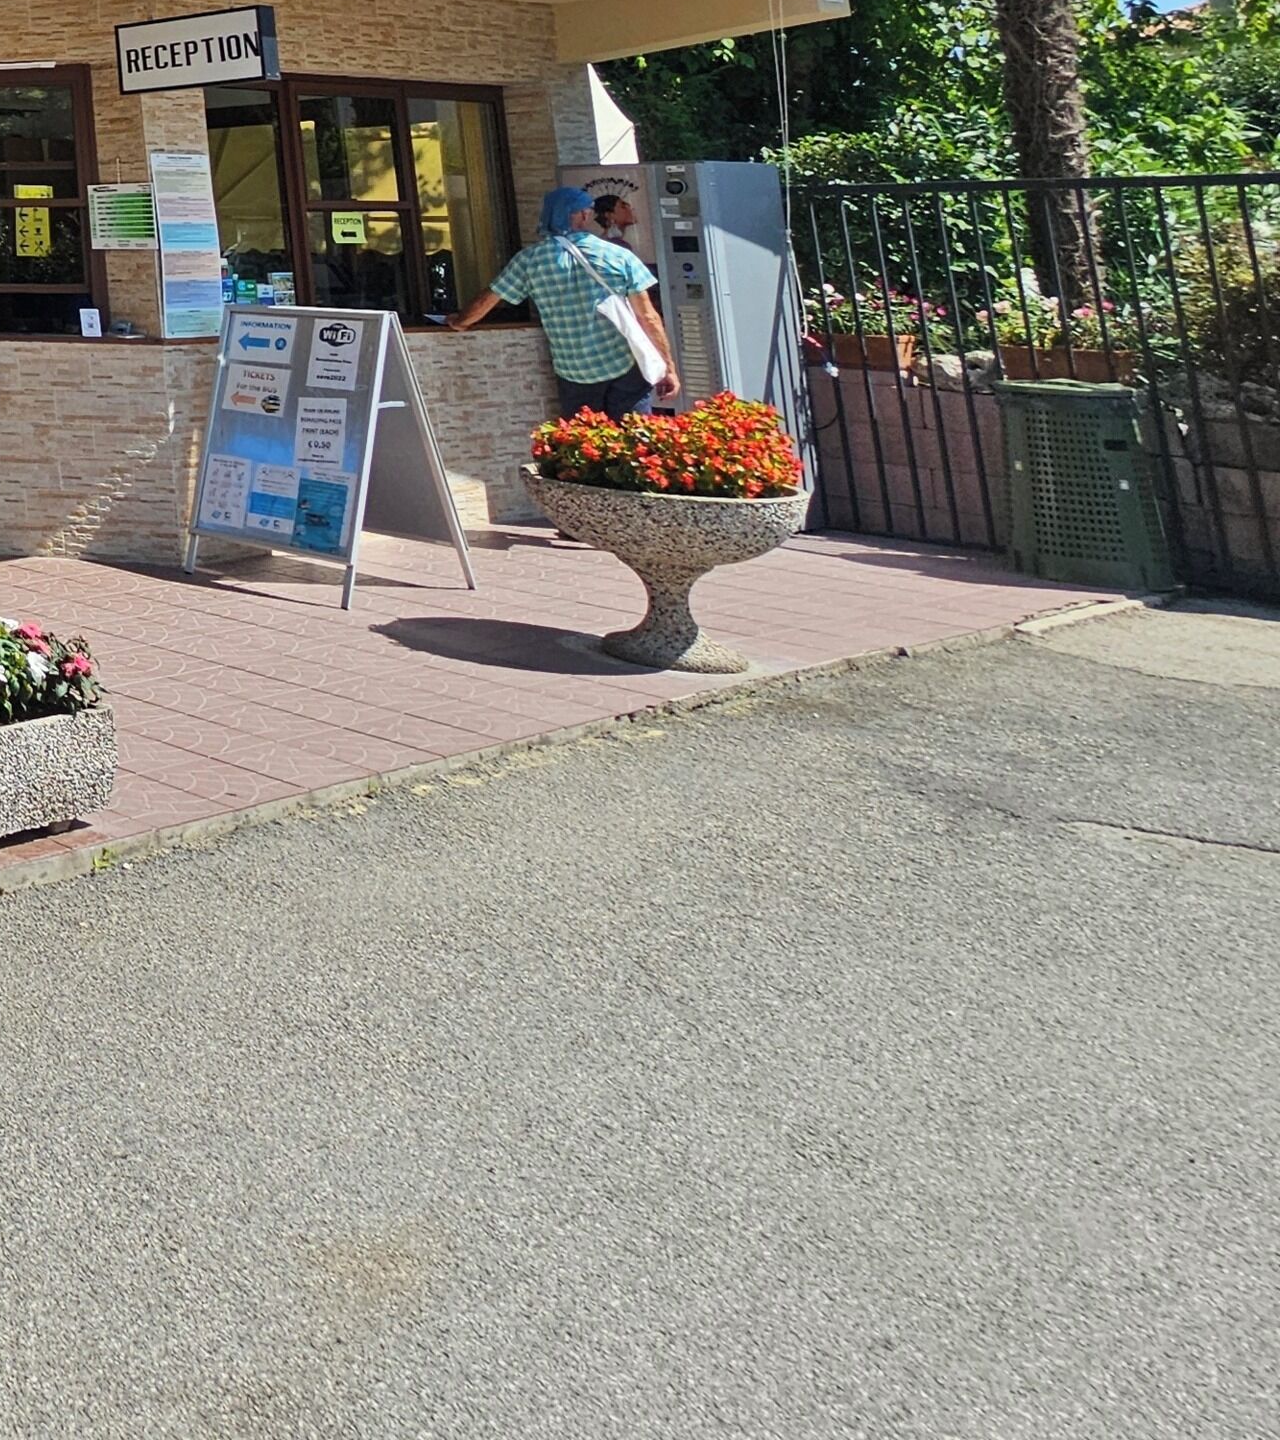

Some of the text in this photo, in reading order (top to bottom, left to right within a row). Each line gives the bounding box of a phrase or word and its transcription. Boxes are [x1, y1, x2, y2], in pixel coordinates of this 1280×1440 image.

[126, 31, 261, 73] RECEPTION
[241, 321, 292, 330] INFORMATION
[243, 369, 276, 381] TICKETS
